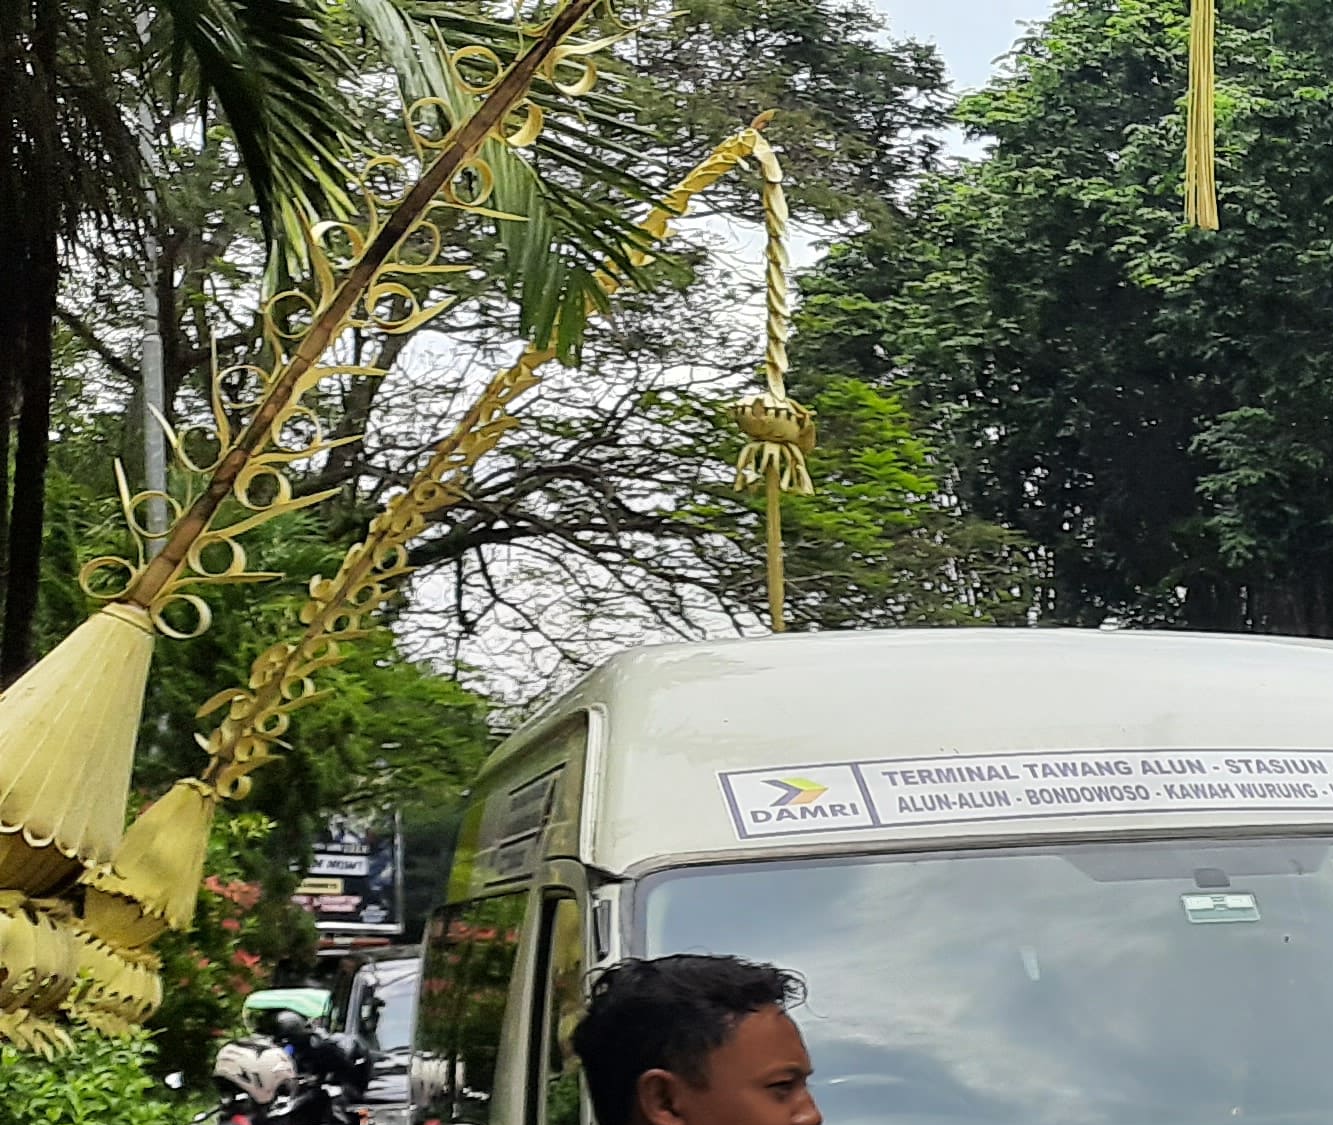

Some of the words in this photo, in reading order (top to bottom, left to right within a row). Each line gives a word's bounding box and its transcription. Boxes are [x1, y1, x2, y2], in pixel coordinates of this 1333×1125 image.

[882, 764, 1019, 787] TERMINAL
[1023, 760, 1132, 780] TAWANG
[1141, 759, 1207, 775] ALUN
[1224, 759, 1328, 775] STASIUN
[898, 789, 1011, 813] ALUN-ALUN
[1025, 785, 1149, 806] BONDOWOSO
[1163, 783, 1234, 800] KAWAH
[1235, 783, 1318, 799] WURUNG
[750, 802, 860, 824] DAMRI
